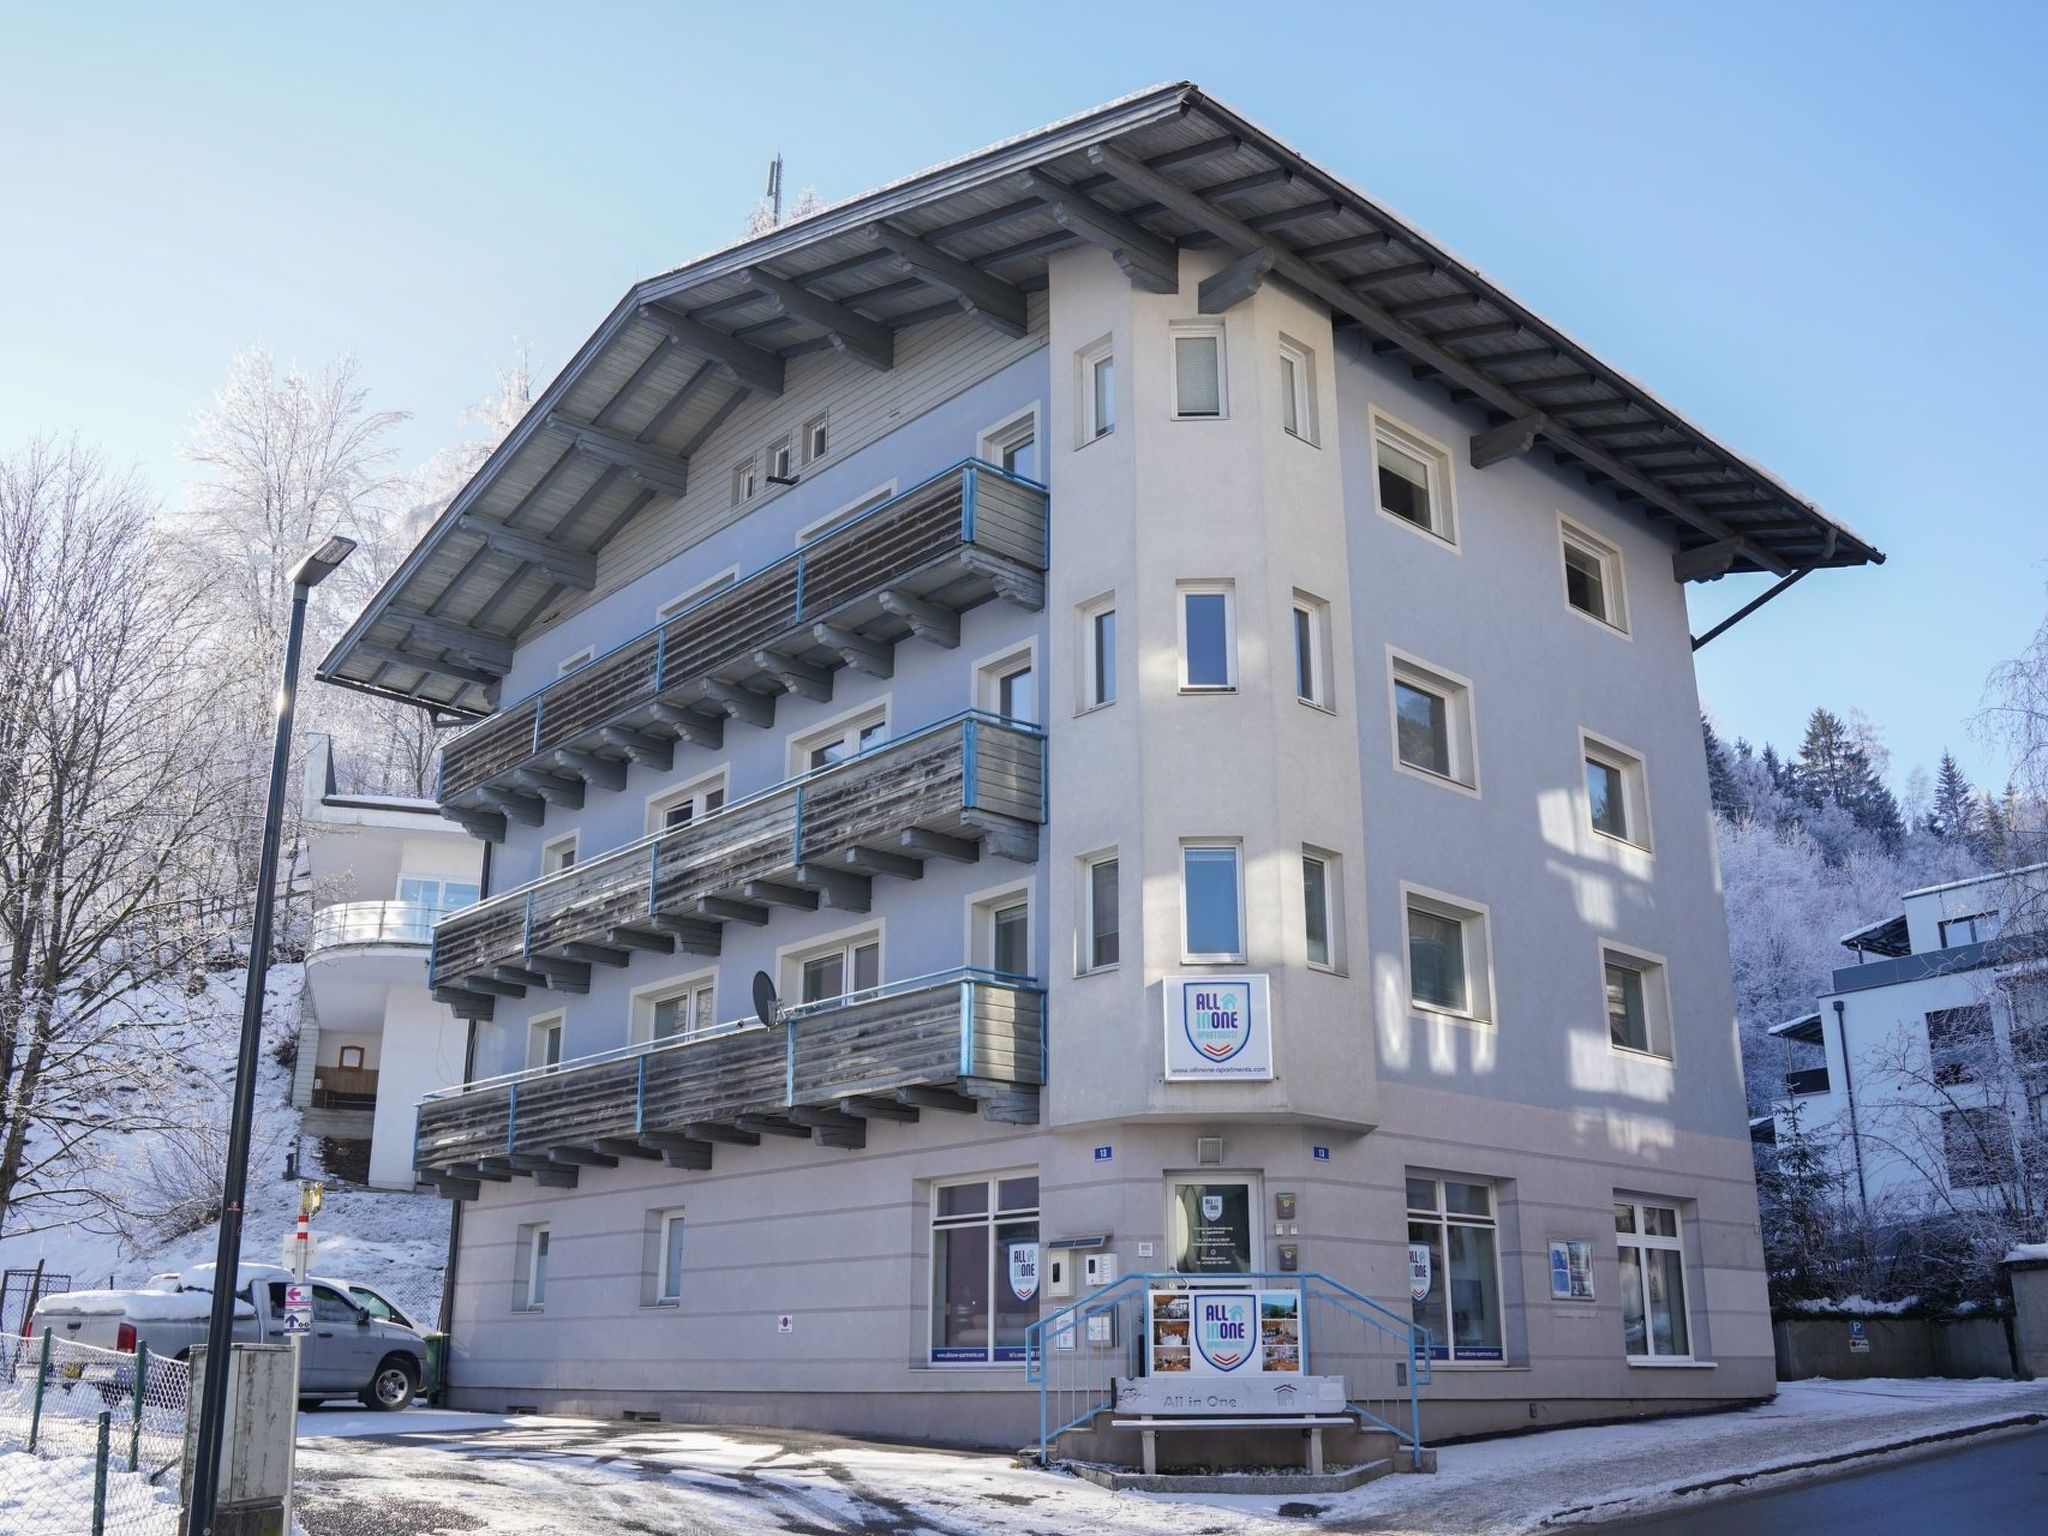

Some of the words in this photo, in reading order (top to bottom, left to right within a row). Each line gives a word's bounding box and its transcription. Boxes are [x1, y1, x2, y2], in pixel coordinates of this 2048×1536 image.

[1196, 993, 1220, 1010] ALL
[1100, 1149, 1107, 1157] 13
[1014, 1250, 1026, 1263] ALL
[1206, 1305, 1228, 1321] ALL
[1853, 1322, 1861, 1332] P
[1163, 1396, 1183, 1408] All
[1188, 1396, 1201, 1408] in
[1207, 1395, 1237, 1408] One
